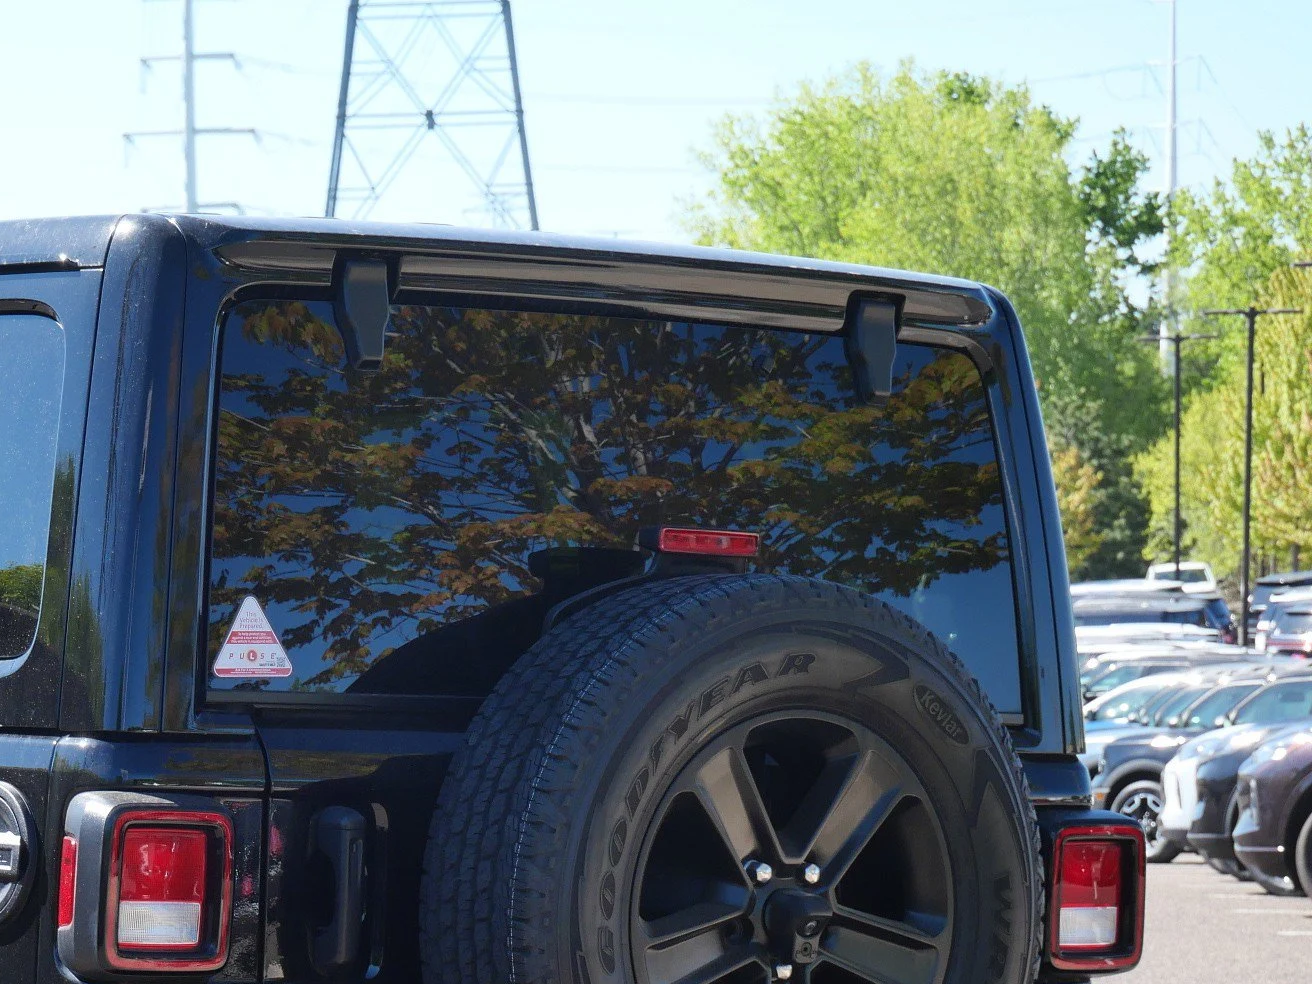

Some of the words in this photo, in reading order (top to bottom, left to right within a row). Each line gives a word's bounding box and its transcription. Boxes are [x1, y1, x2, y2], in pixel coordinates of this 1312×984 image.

[228, 650, 276, 661] PULSE
[914, 689, 961, 738] Kevlar
[597, 652, 816, 977] GOODYEAR
